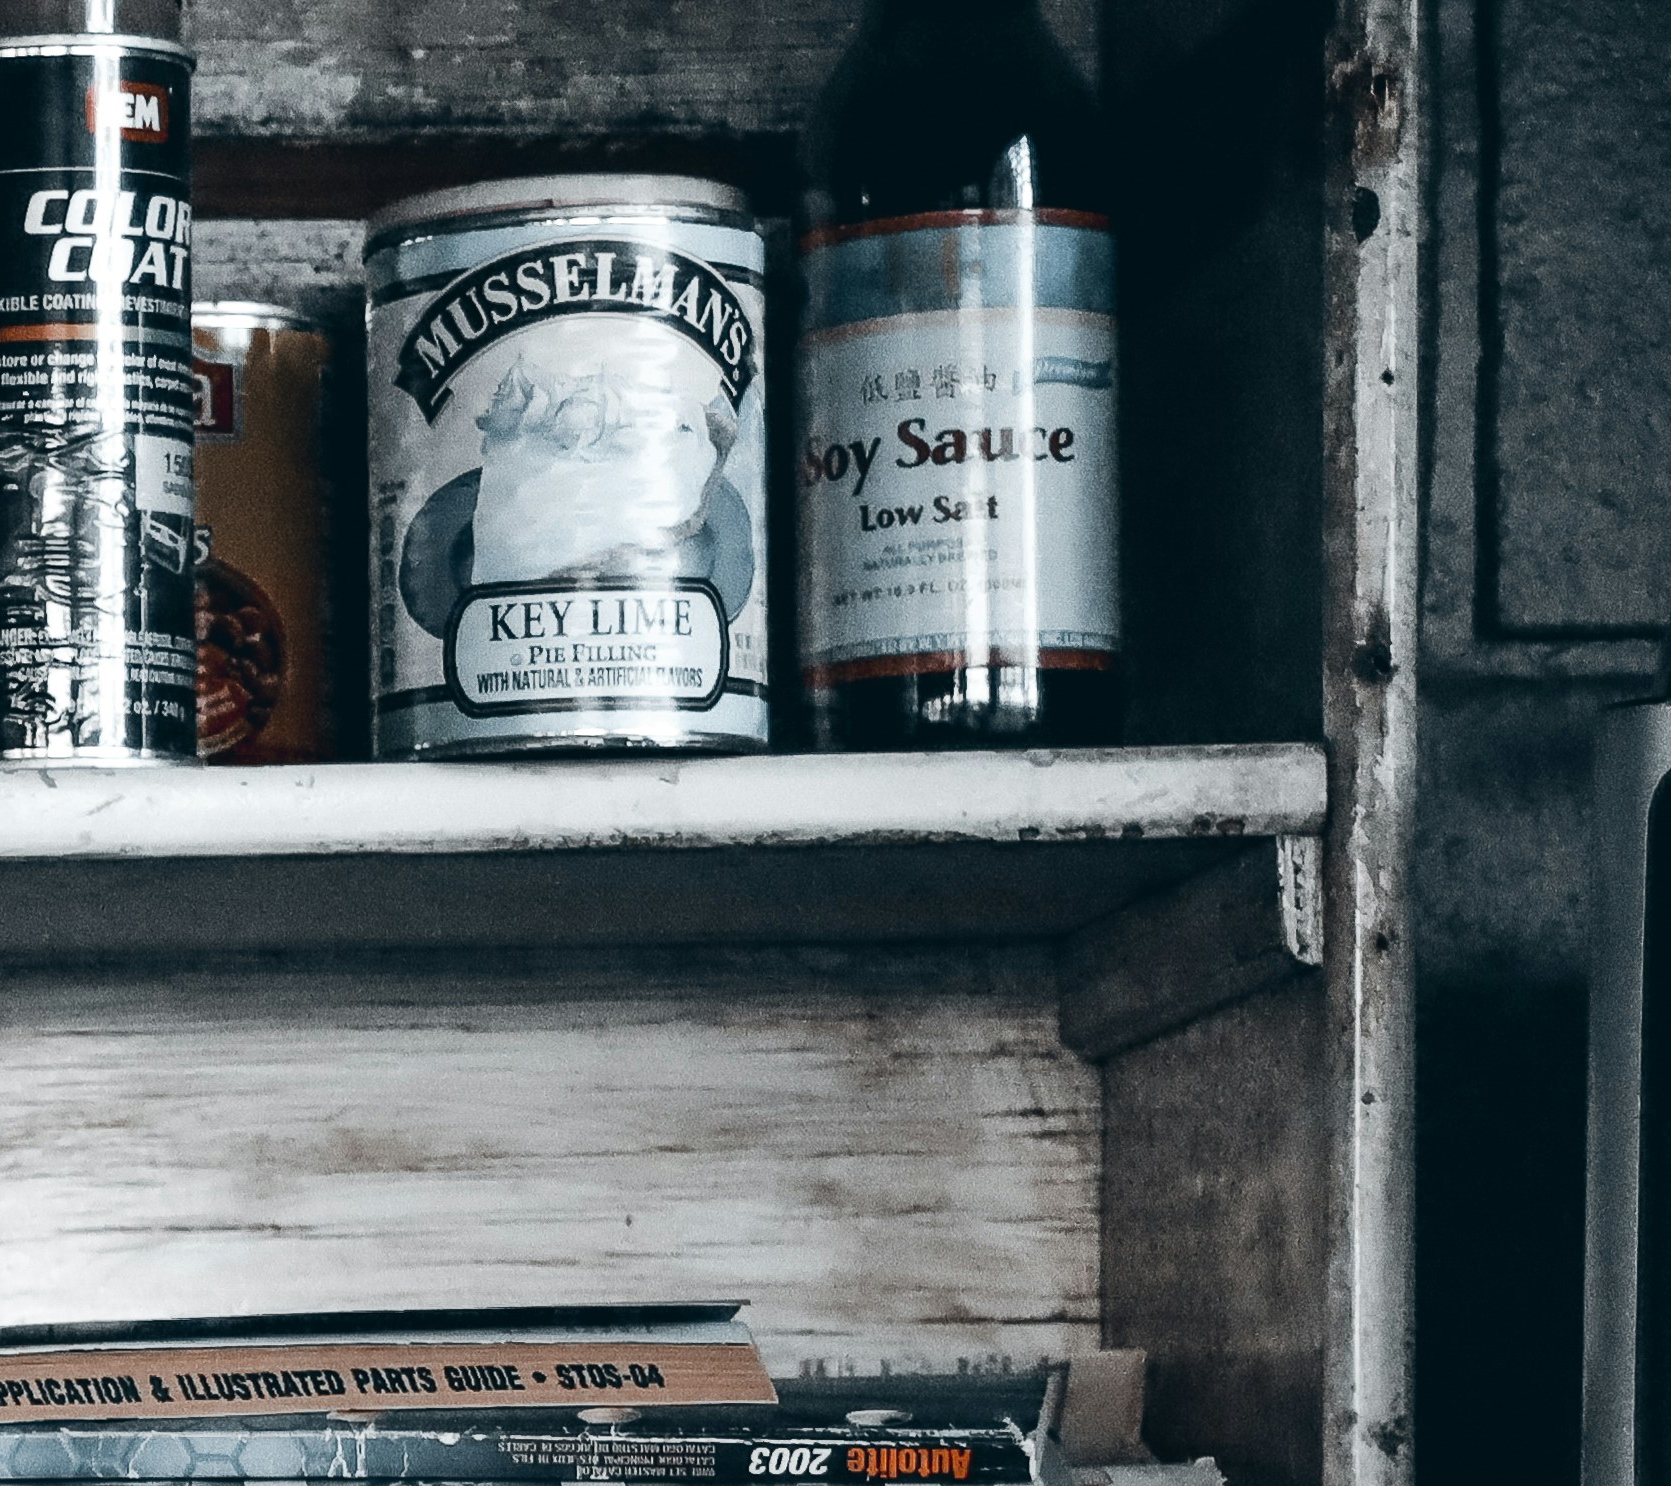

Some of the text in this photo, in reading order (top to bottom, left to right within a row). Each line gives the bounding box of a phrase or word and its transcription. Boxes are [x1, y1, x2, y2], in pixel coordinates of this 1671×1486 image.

[23, 189, 192, 243] COLOR
[48, 236, 189, 289] COAT
[42, 293, 102, 313] COATIN
[415, 251, 749, 381] MUSSELMAN'S
[801, 416, 1077, 497] Soy Sauce
[859, 501, 922, 533] Low
[487, 598, 693, 642] KEY LIME
[527, 643, 658, 666] PIE FILLING
[475, 671, 509, 694] WITH
[510, 668, 572, 691] NATURAL
[586, 667, 654, 689] ARTIFICIAL
[148, 1374, 175, 1404] &
[175, 1368, 347, 1402] ILLUSTRATED
[349, 1365, 439, 1395] PARTS
[442, 1363, 526, 1393] GUIDE
[553, 1362, 666, 1391] STOS-04
[747, 1445, 971, 1480] Autolite 2003
